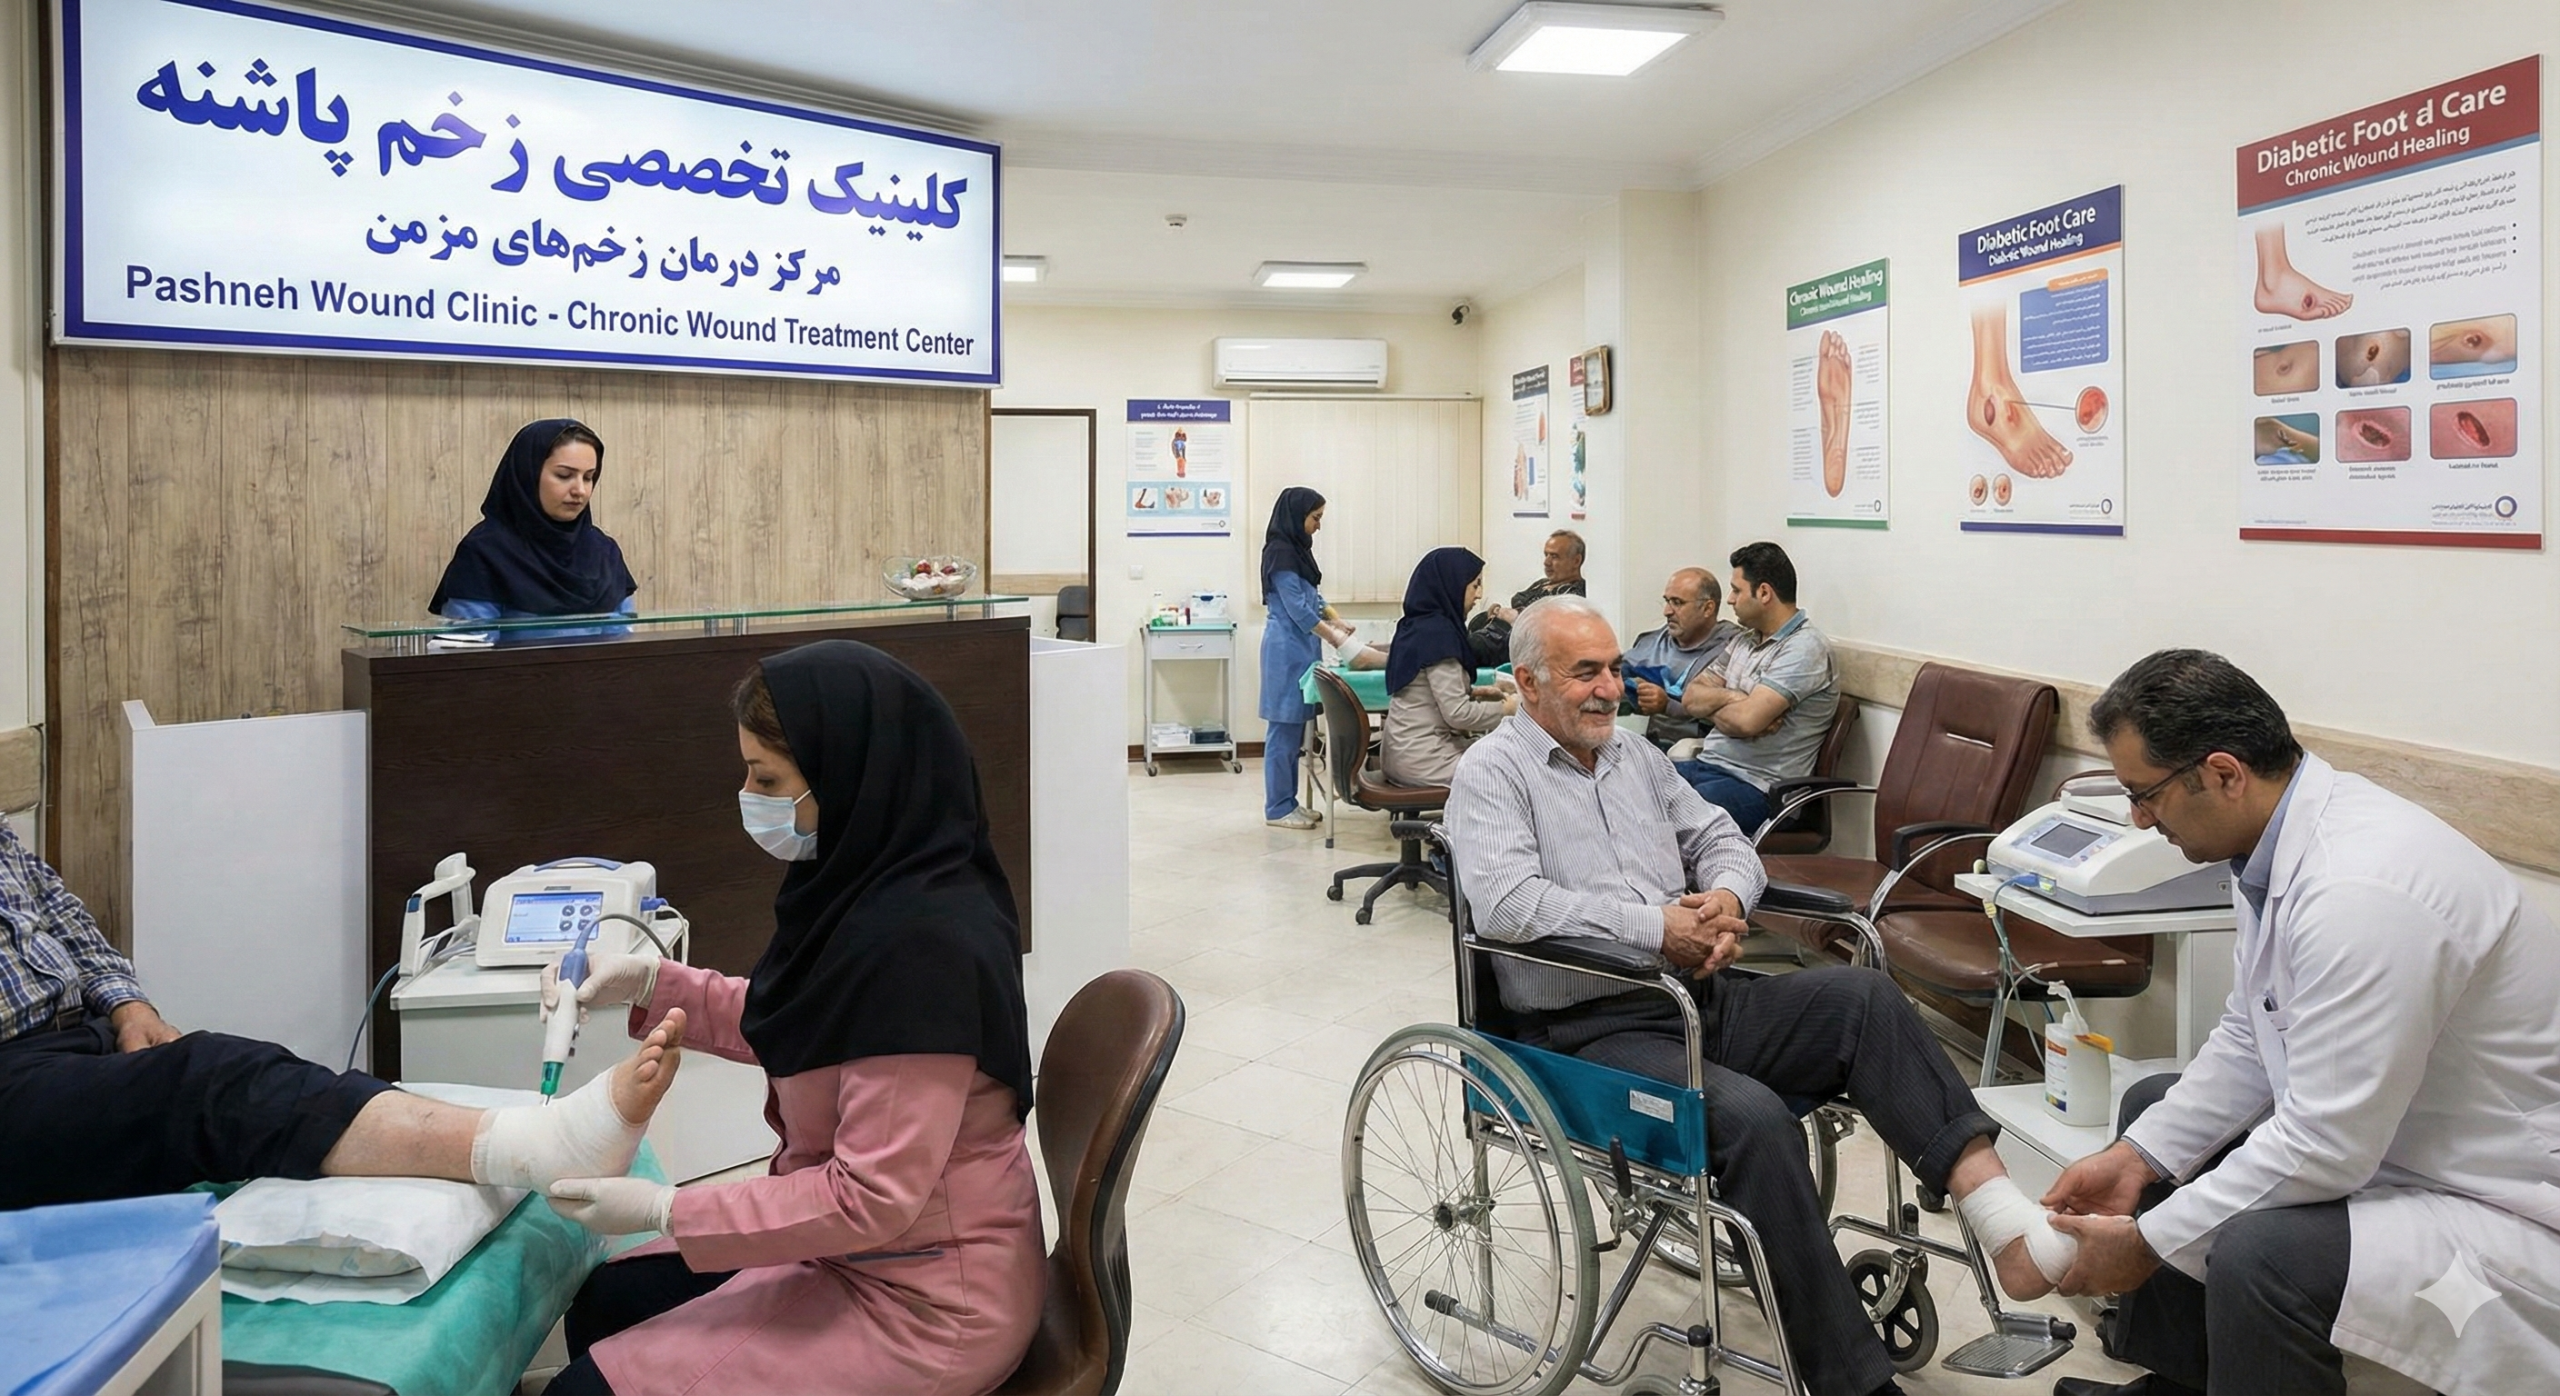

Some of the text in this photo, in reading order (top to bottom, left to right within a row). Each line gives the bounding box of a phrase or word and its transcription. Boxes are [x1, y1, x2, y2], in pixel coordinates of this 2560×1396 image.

[136, 57, 968, 242] کلینیک تخصصی زخم پاشنه
[2257, 129, 2347, 173] Diabetic
[2353, 109, 2408, 147] Foot
[2441, 84, 2507, 118] Care
[2285, 125, 2470, 187] Chronic Wound Healing
[365, 214, 841, 296] مرکز درمان زخم‌های مزمن
[2030, 214, 2060, 239] Foot
[2062, 206, 2096, 229] Care
[126, 265, 299, 311] Pashneh
[310, 279, 435, 320] Wound
[447, 290, 538, 327] Clinic
[567, 301, 679, 336] Chronic
[686, 309, 776, 343] Wound
[783, 317, 900, 352] Treatment
[905, 328, 975, 356] Center
